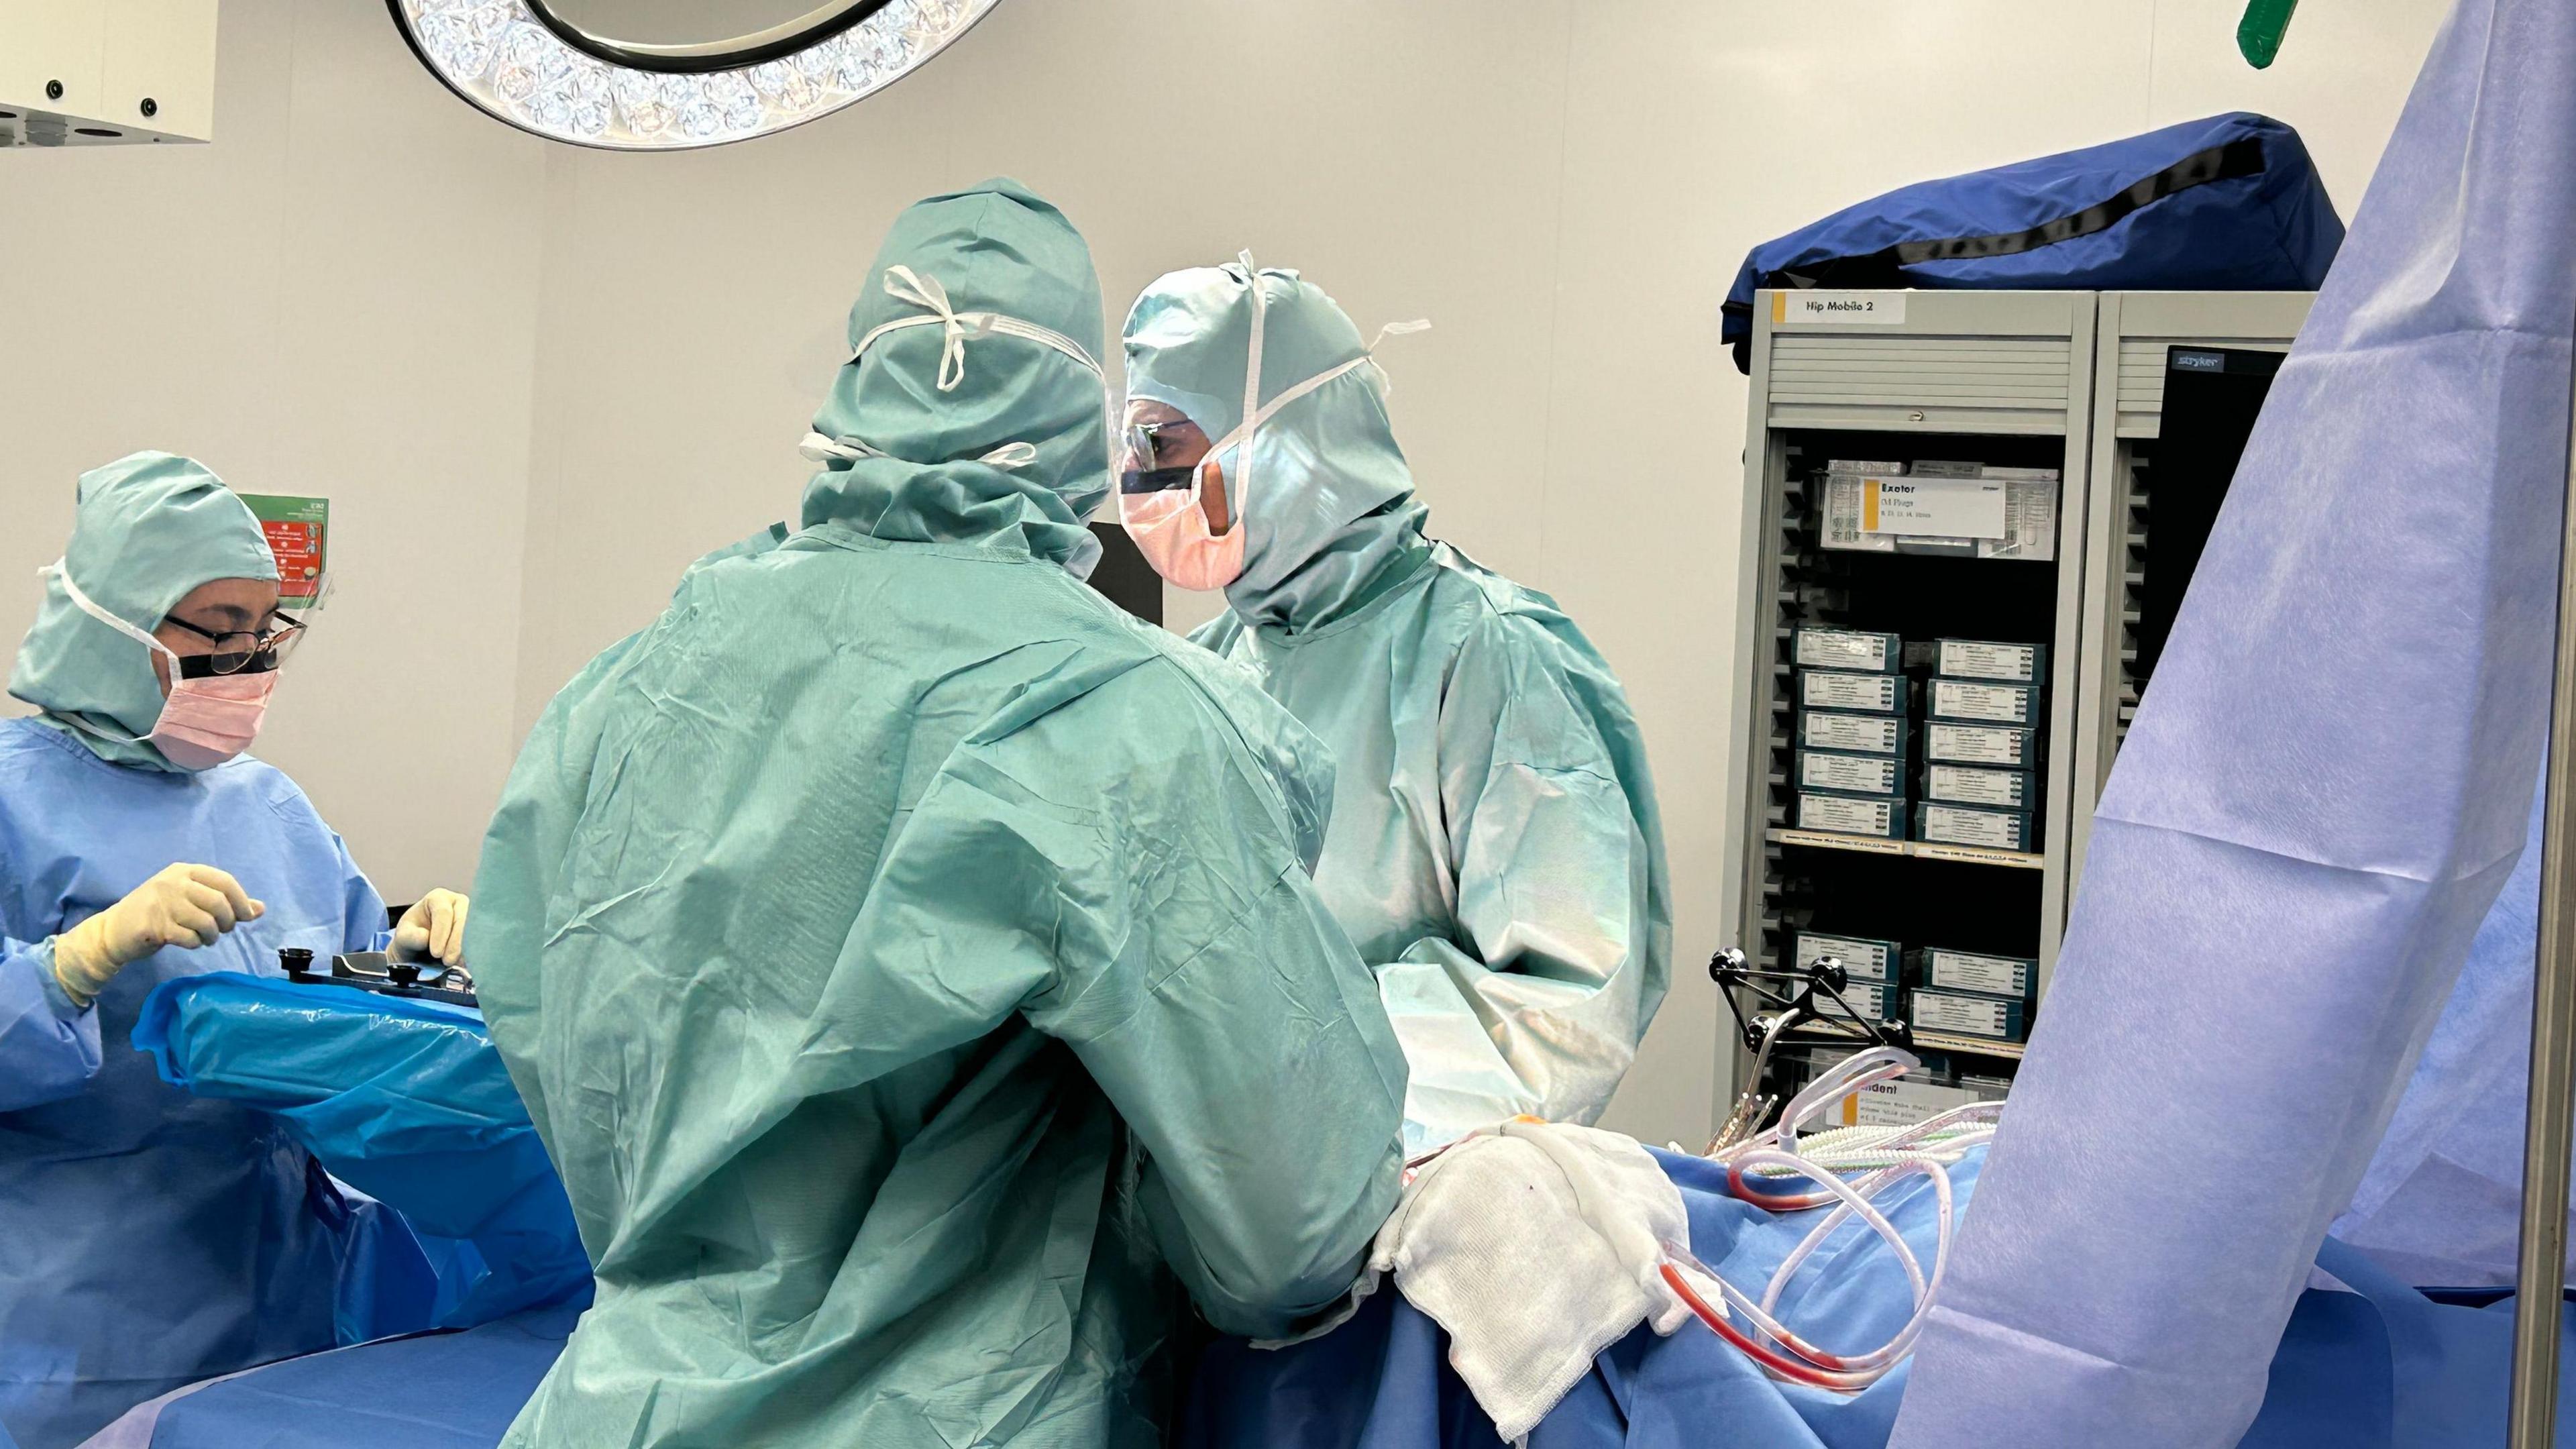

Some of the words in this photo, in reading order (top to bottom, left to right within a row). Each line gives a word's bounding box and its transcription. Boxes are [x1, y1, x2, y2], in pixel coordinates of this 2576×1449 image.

[1806, 301, 1824, 313] Hip
[1866, 301, 1874, 311] 2
[2178, 356, 2218, 367] stryker
